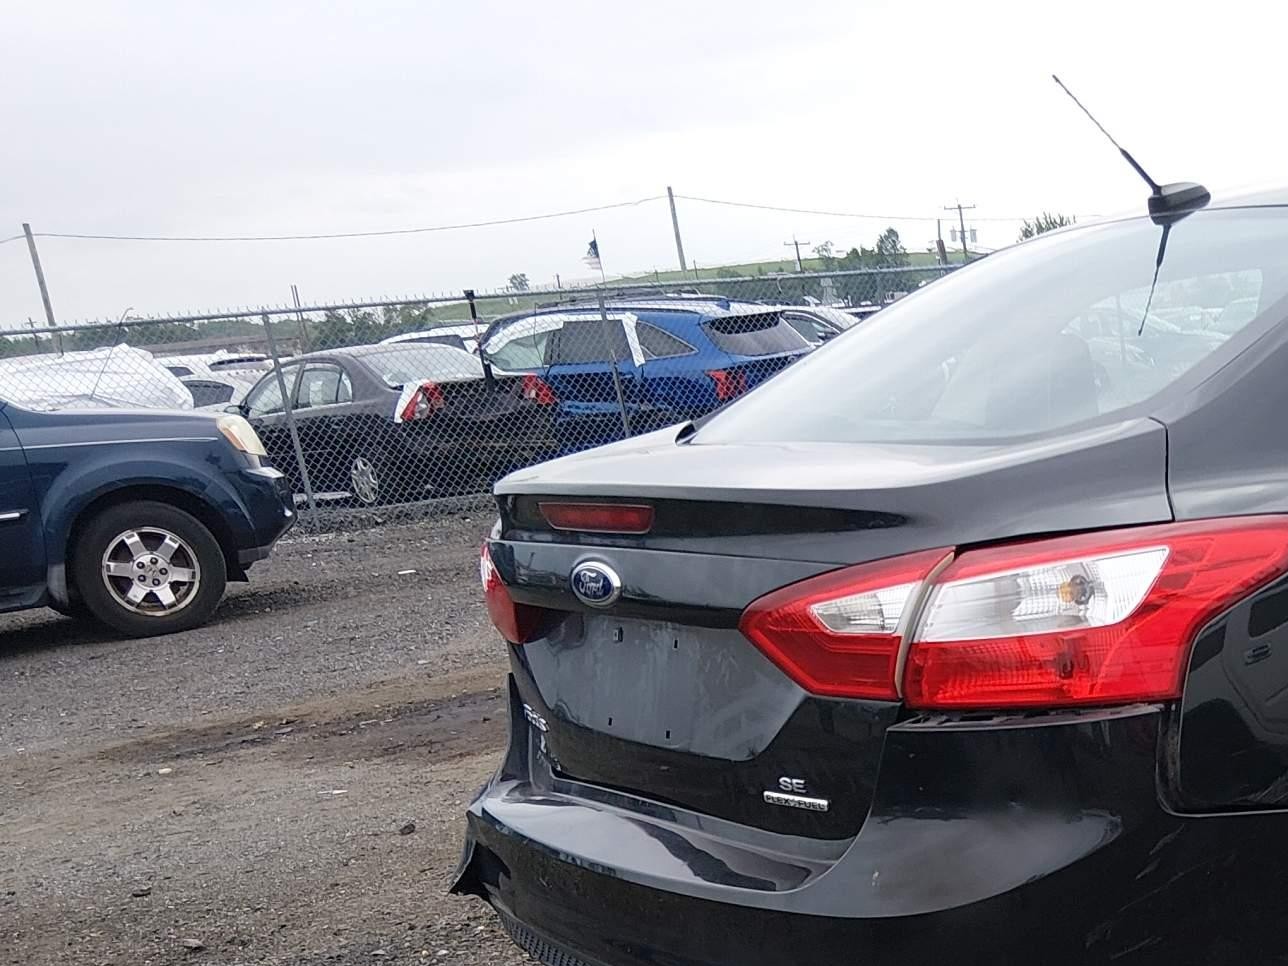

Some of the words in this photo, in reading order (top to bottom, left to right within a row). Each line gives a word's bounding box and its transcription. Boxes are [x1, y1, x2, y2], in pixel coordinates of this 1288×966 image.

[579, 570, 604, 595] Ford
[779, 776, 807, 793] SE
[766, 795, 791, 805] FLEX
[799, 801, 826, 810] FUEL
